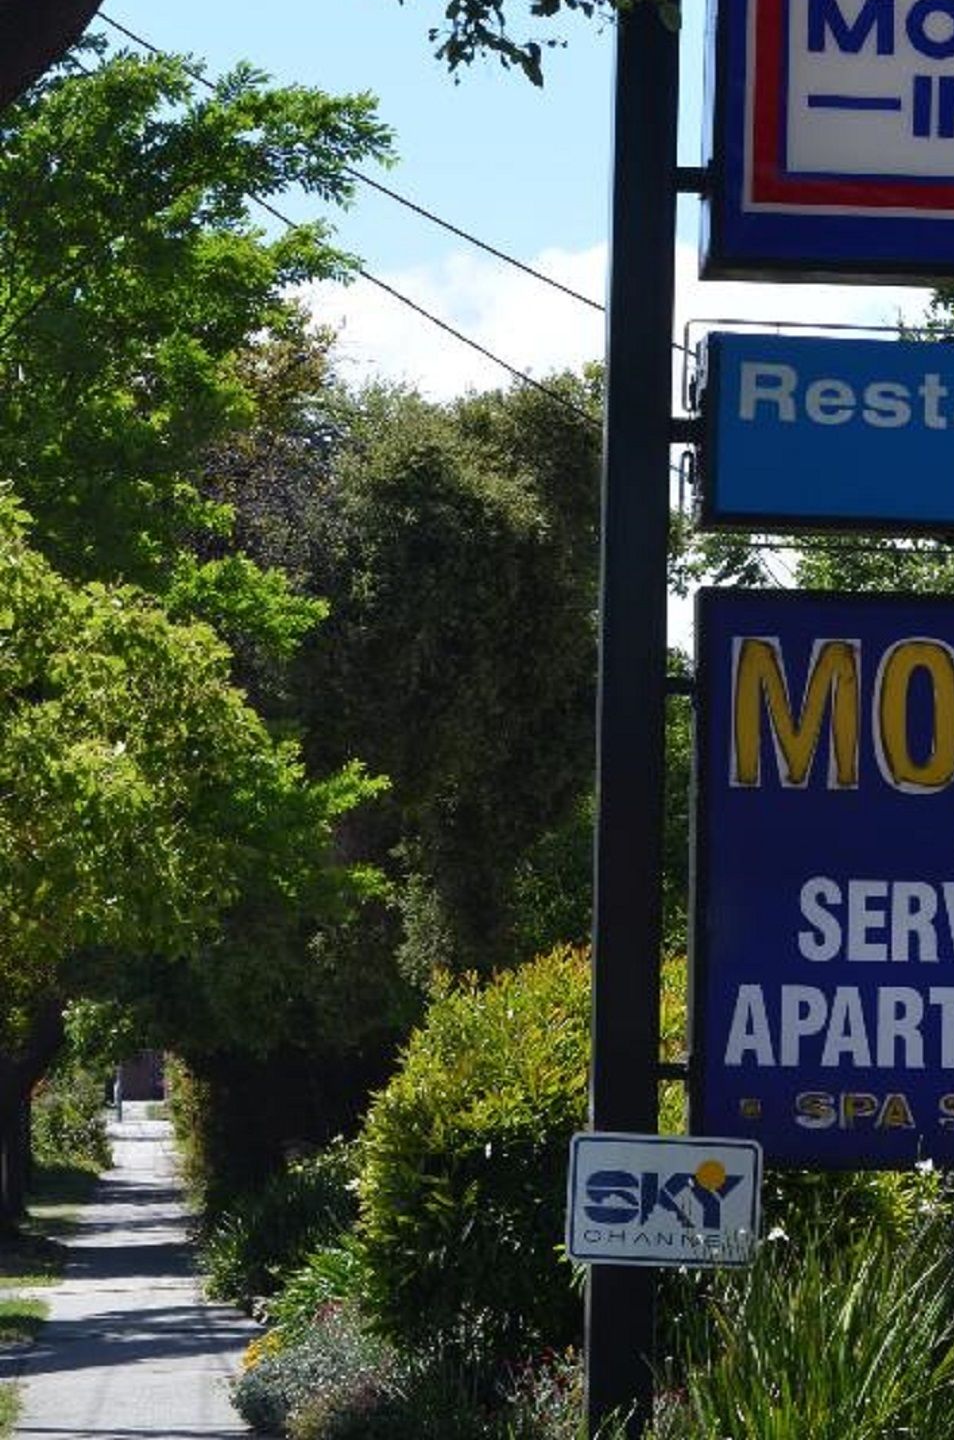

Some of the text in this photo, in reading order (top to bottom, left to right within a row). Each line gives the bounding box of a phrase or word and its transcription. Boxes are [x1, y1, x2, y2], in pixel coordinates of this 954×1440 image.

[795, 1091, 915, 1130] SPA
[583, 1169, 744, 1229] SKY
[583, 1229, 742, 1250] CHANNE
